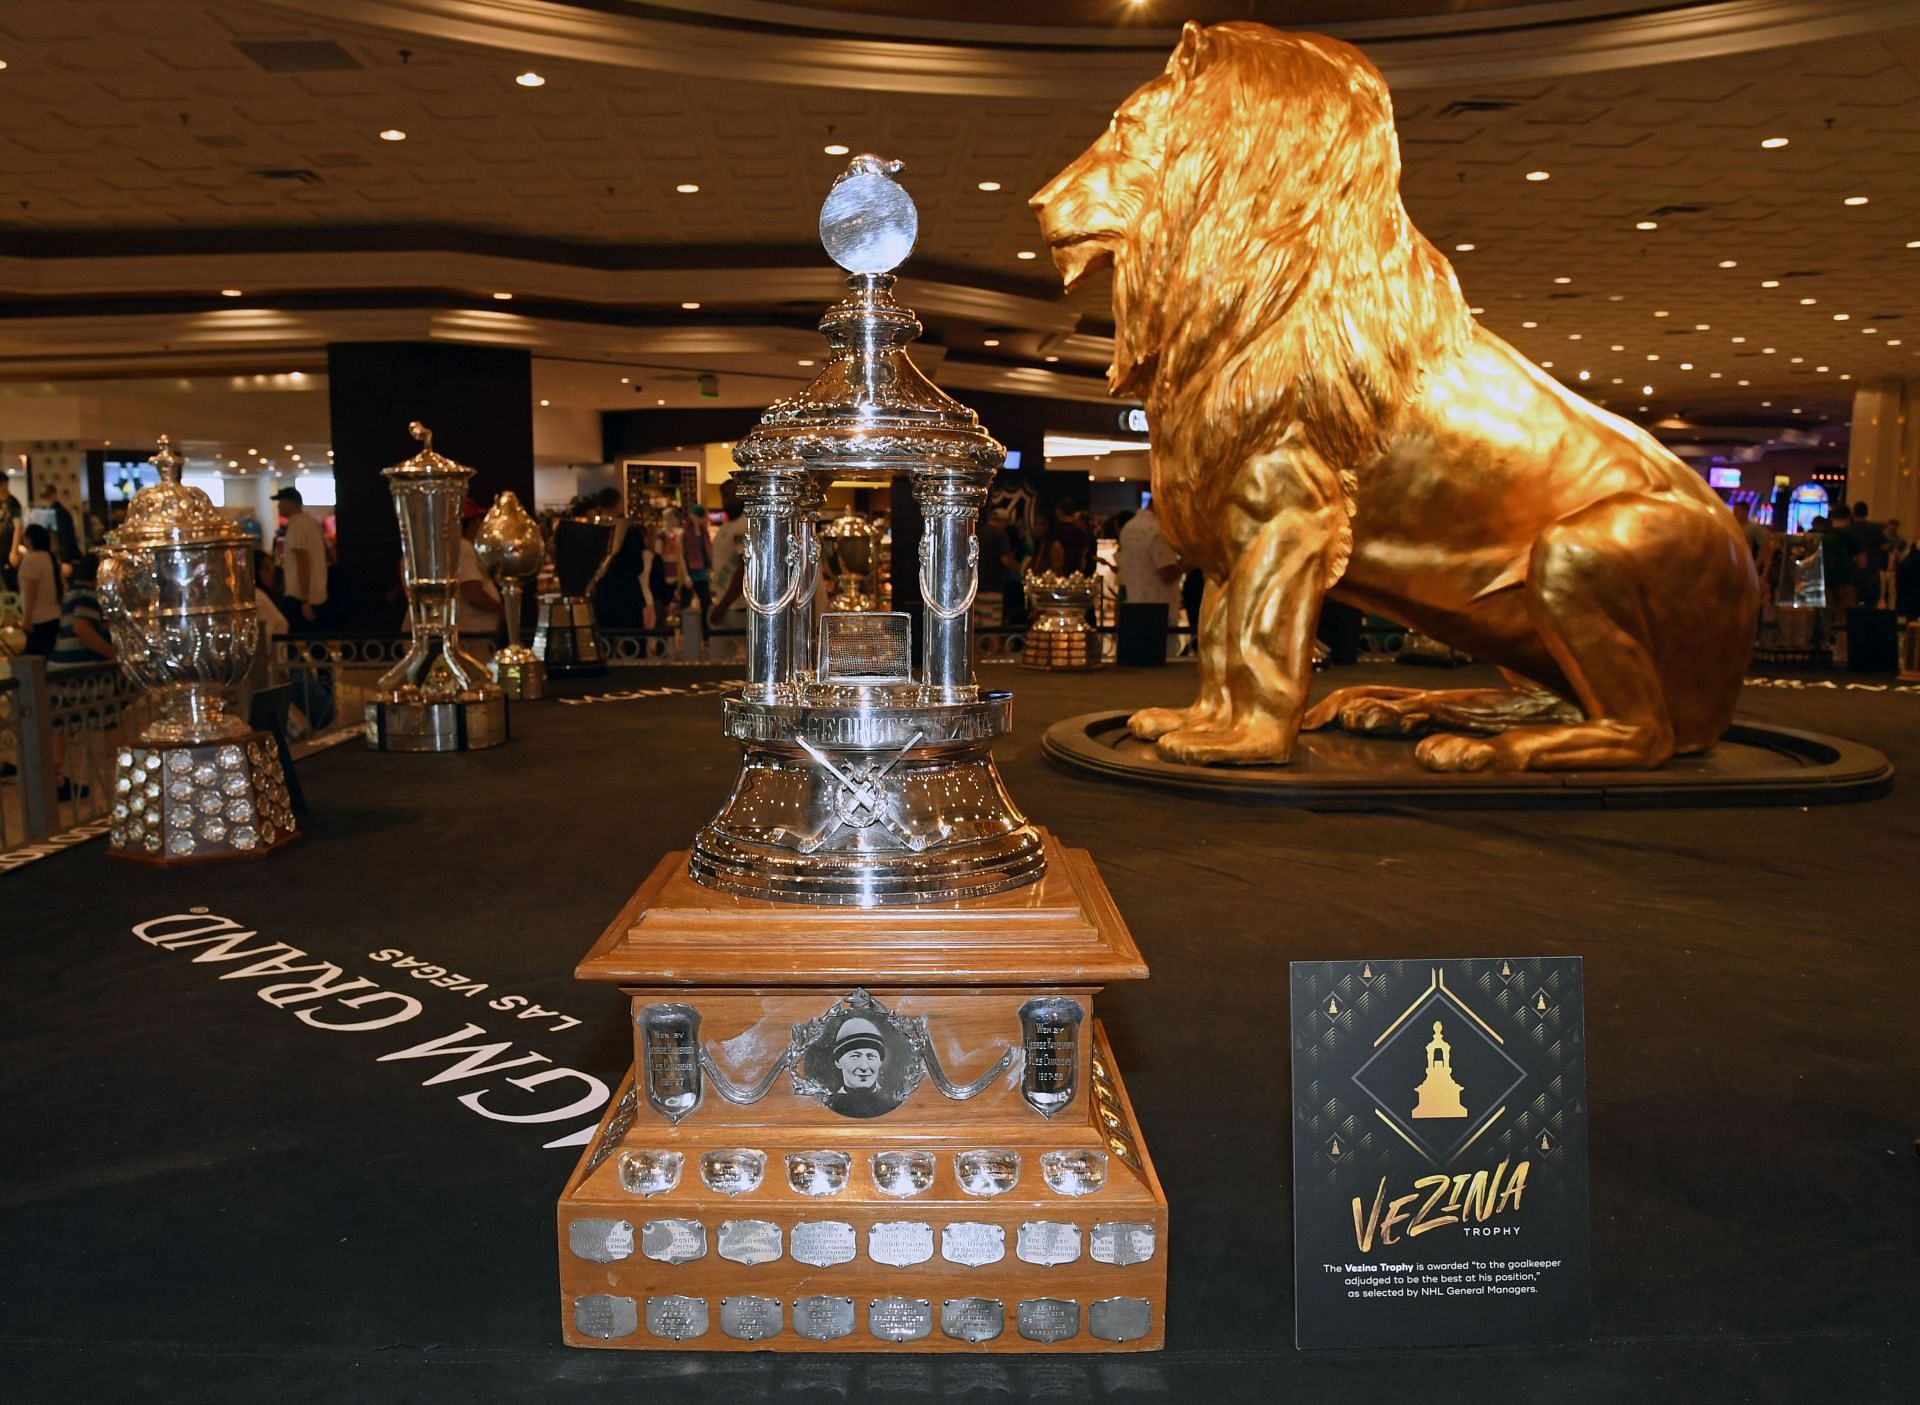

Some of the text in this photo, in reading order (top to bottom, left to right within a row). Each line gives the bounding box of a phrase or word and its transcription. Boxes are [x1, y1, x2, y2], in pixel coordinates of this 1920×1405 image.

[921, 711, 994, 742] VEZINA
[368, 949, 582, 1032] LAS VEGAS
[376, 1022, 610, 1149] GM
[1352, 1154, 1531, 1253] VEZINA
[1463, 1227, 1521, 1237] TROPHY
[1323, 1264, 1343, 1273] The
[1345, 1264, 1378, 1273] Vezina
[1380, 1263, 1414, 1273] Trophy
[1416, 1263, 1425, 1271] is
[1427, 1261, 1469, 1271] awarded
[1489, 1261, 1506, 1269] the
[1508, 1259, 1561, 1270] goalkeeper
[1345, 1276, 1391, 1287] adjudged
[1394, 1277, 1405, 1285] to
[1407, 1276, 1420, 1285] be
[1422, 1276, 1439, 1285] the
[1441, 1275, 1463, 1284] best
[1465, 1275, 1477, 1283] at
[1479, 1273, 1493, 1282] his
[1348, 1285, 1538, 1298] as selected by NHL General Managers.
